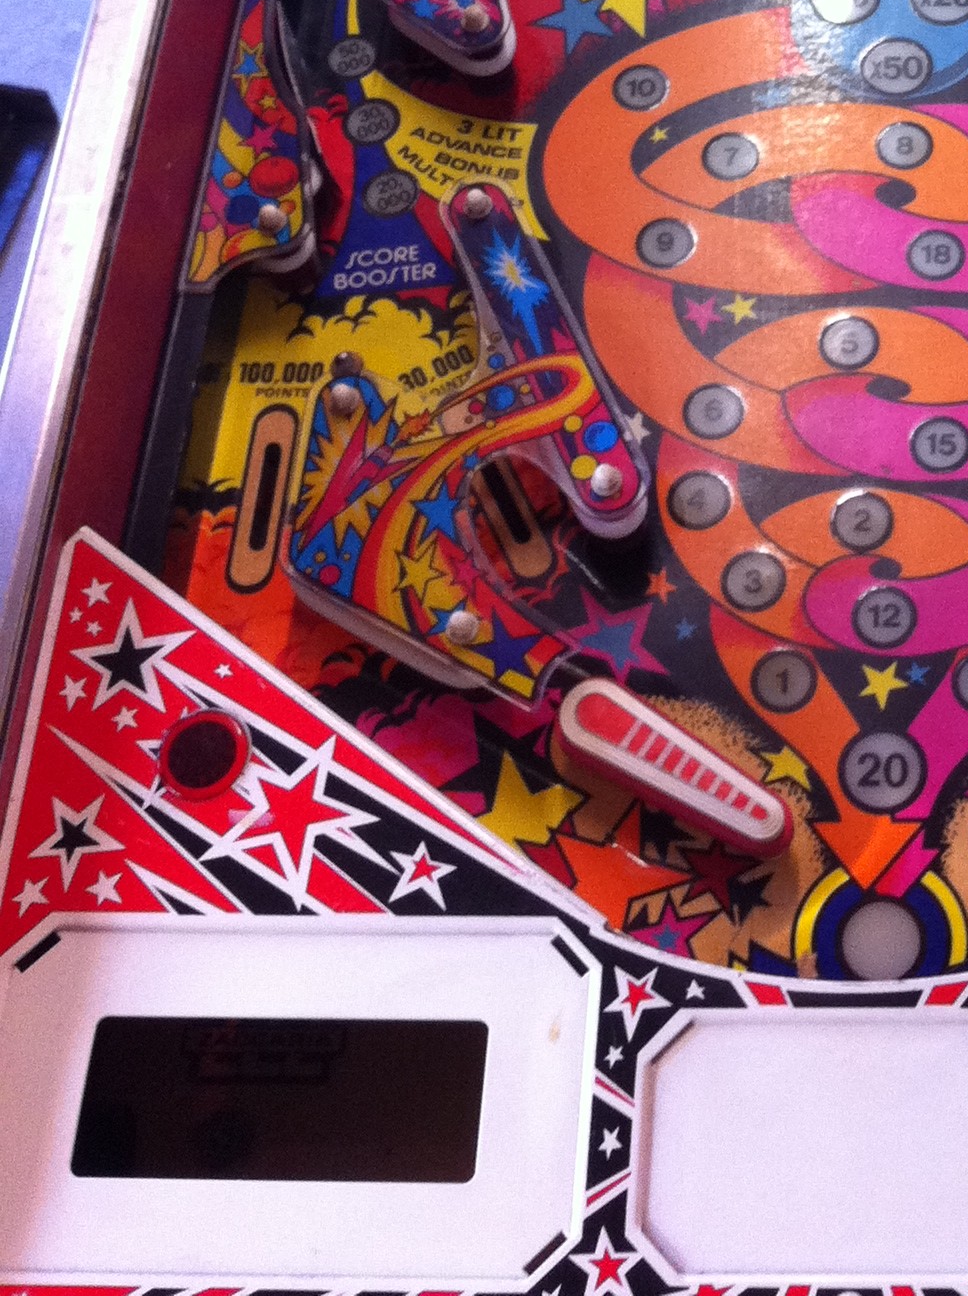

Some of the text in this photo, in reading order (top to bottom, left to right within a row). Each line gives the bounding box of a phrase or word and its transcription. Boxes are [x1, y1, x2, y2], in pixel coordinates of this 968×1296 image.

[870, 54, 923, 83] x50
[625, 78, 657, 99] 10
[456, 119, 522, 142] 3 LIT
[410, 127, 522, 159] ADVANCE
[723, 147, 738, 167] 7
[656, 233, 675, 254] 9
[922, 244, 951, 265] 18
[345, 244, 420, 270] SCORE
[333, 263, 437, 291] BOOSTER
[239, 361, 324, 384] 100.000
[398, 345, 475, 391] 30.000
[926, 433, 957, 456] 15
[853, 508, 873, 533] 2
[744, 569, 763, 594] 3
[866, 605, 901, 629] 12
[777, 669, 790, 693] 1
[856, 750, 910, 787] 20
